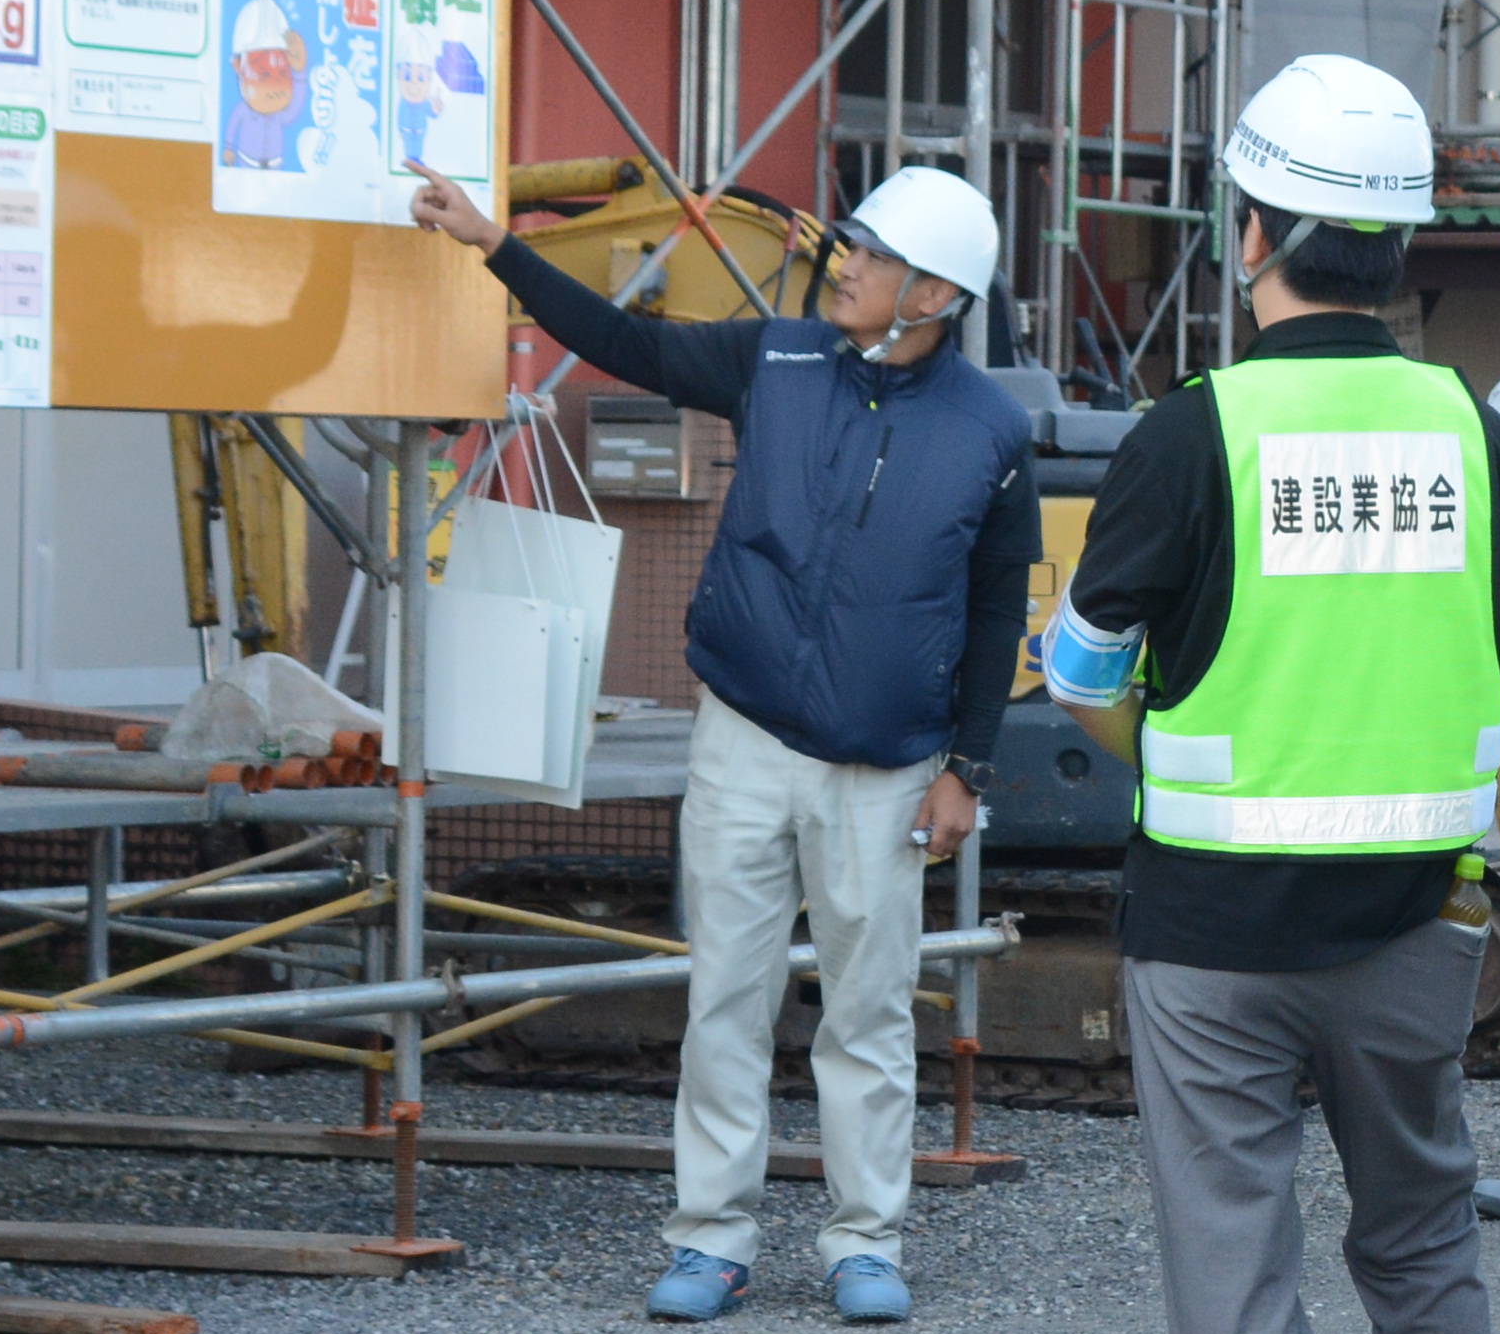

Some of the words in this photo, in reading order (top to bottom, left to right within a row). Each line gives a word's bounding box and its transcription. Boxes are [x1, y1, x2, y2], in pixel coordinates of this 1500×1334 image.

[1271, 471, 1457, 537] 建設業協会
